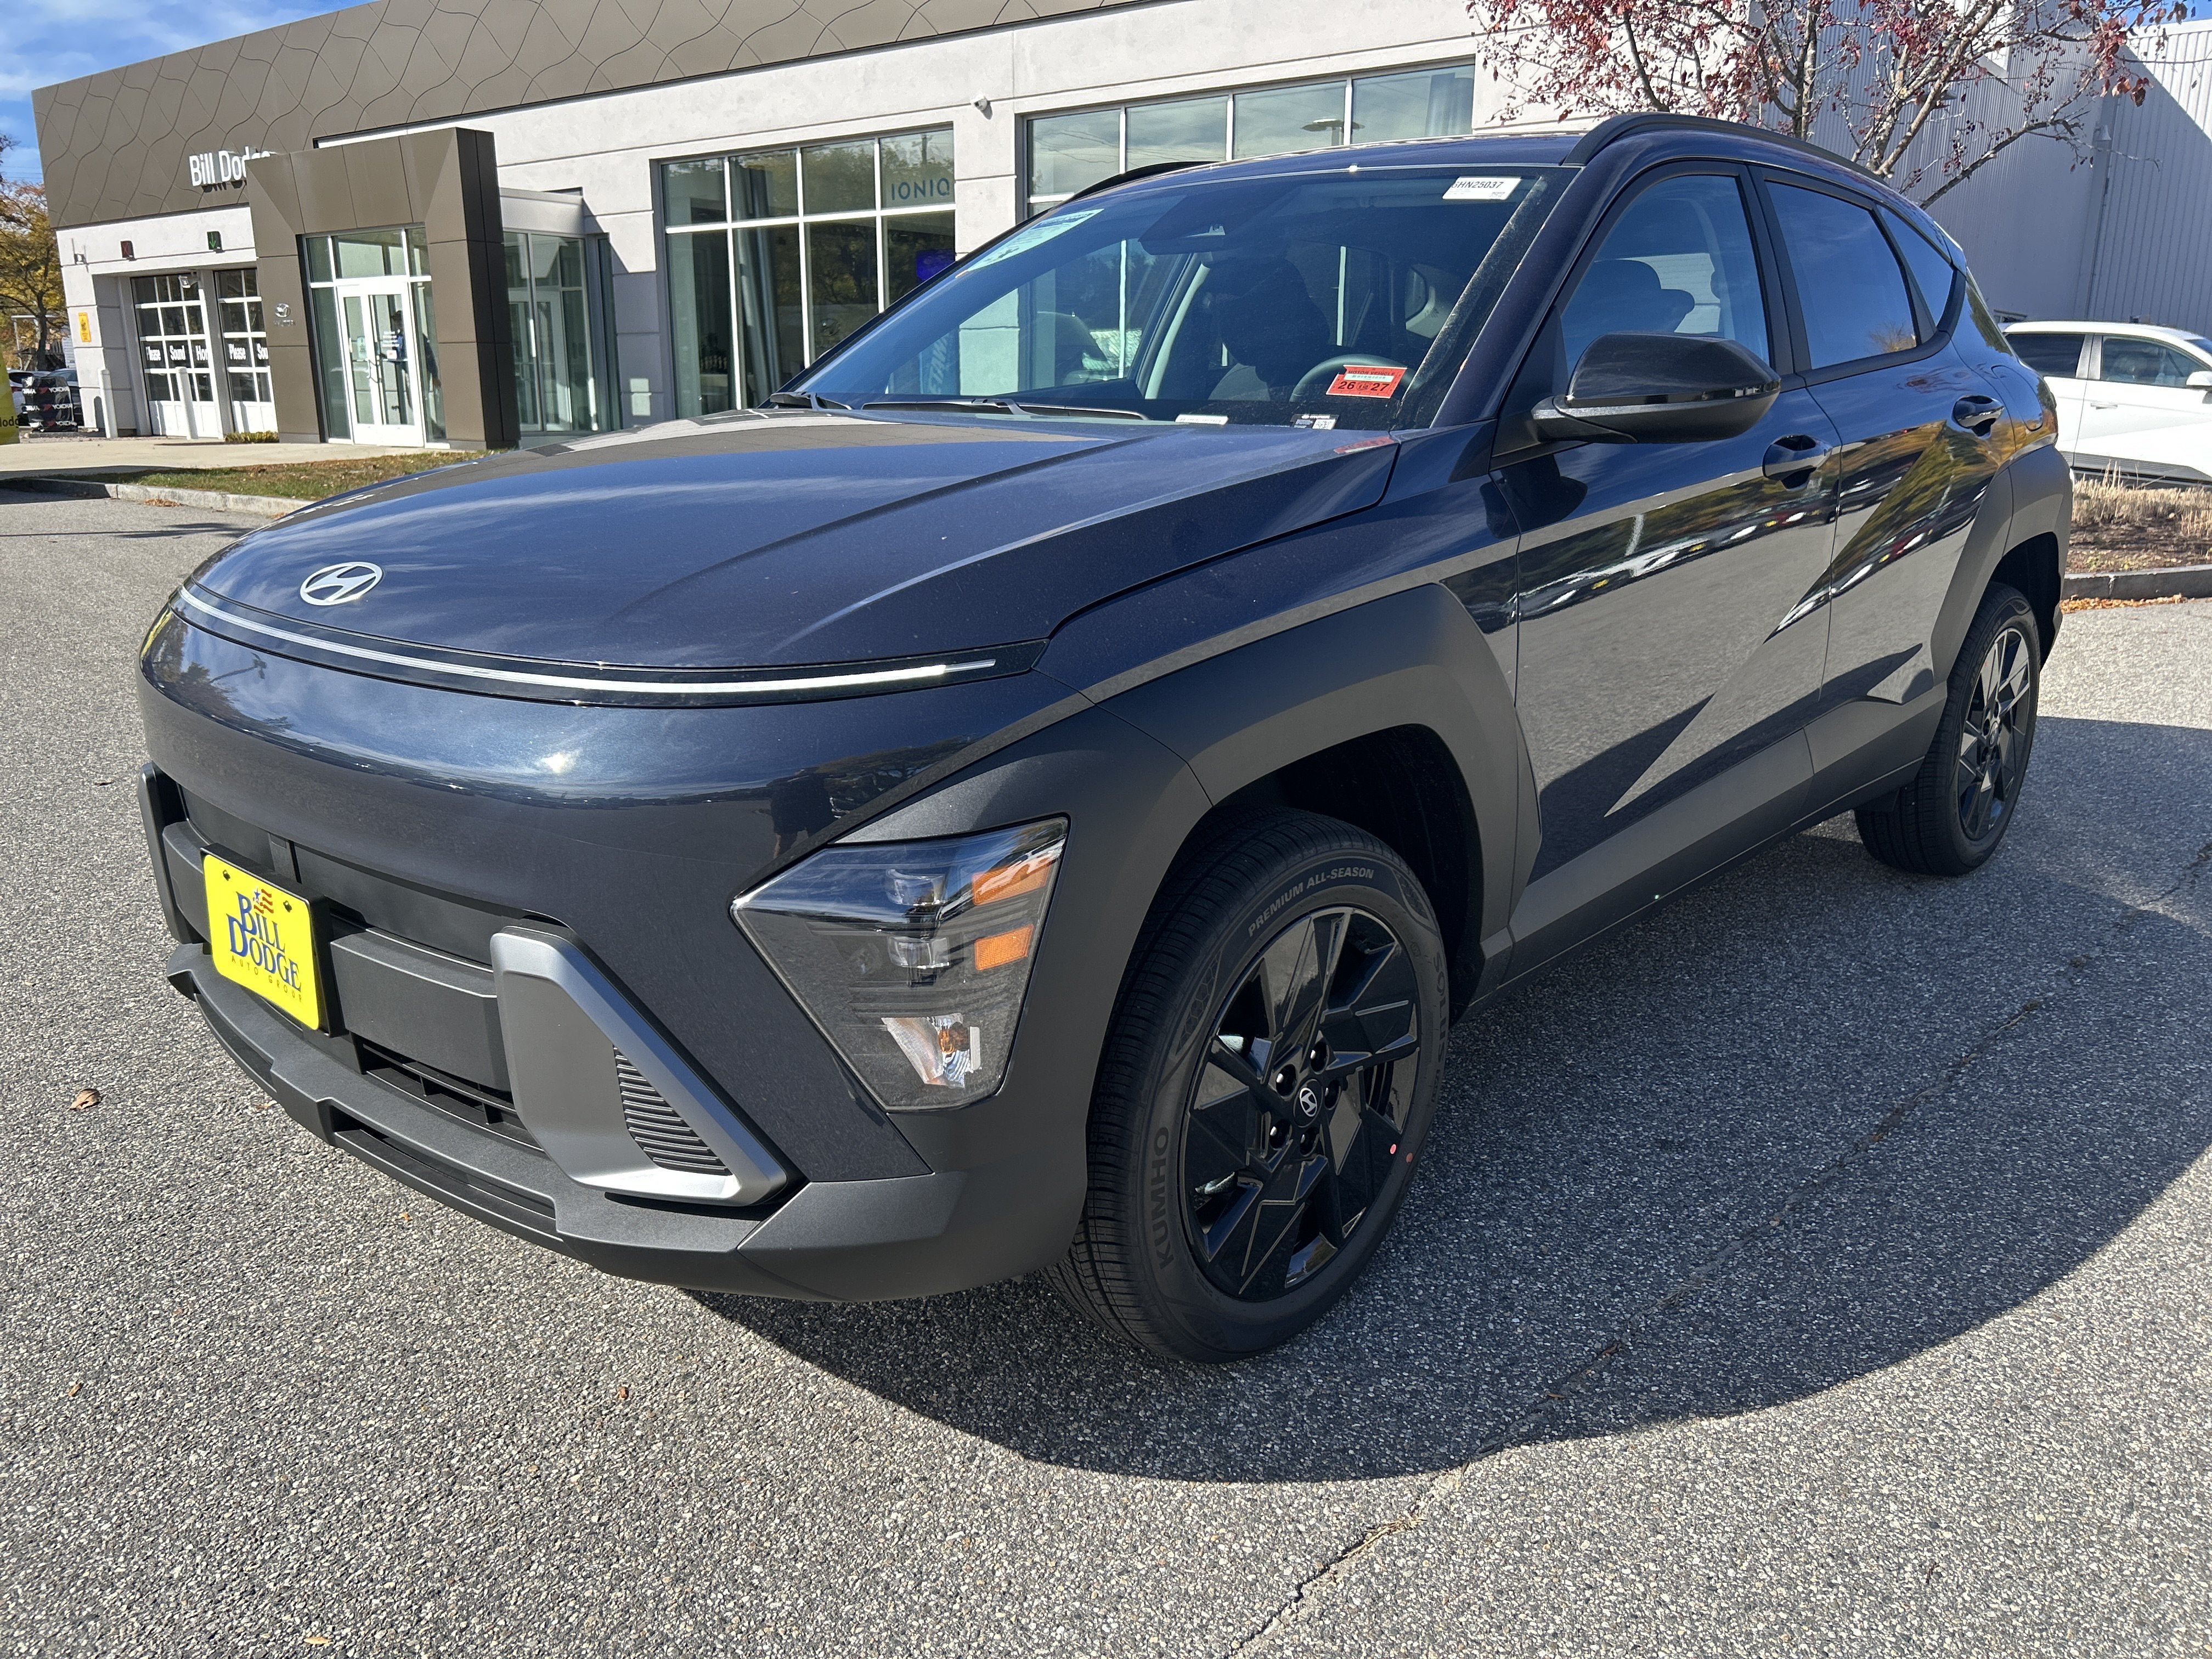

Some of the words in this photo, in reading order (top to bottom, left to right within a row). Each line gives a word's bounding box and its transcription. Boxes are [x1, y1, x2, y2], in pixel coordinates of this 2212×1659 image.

[189, 152, 216, 187] Bill
[218, 146, 270, 182] Dod
[891, 178, 950, 200] IONIQ
[146, 345, 161, 360] Please
[170, 345, 186, 360] Sound
[195, 345, 208, 360] Hor
[228, 343, 246, 360] Please
[257, 343, 269, 360] Sou
[1338, 381, 1356, 390] 26
[1370, 383, 1390, 391] 27
[236, 891, 285, 953] BILL
[1248, 882, 1304, 937] PREMIUM
[1306, 867, 1374, 889] ALL-SEASON
[226, 913, 301, 992] DODGE
[232, 955, 258, 975] AUTO
[268, 975, 302, 1003] GROUP
[1433, 951, 1447, 1063] SOLUS
[1150, 1127, 1174, 1269] KUMHO
